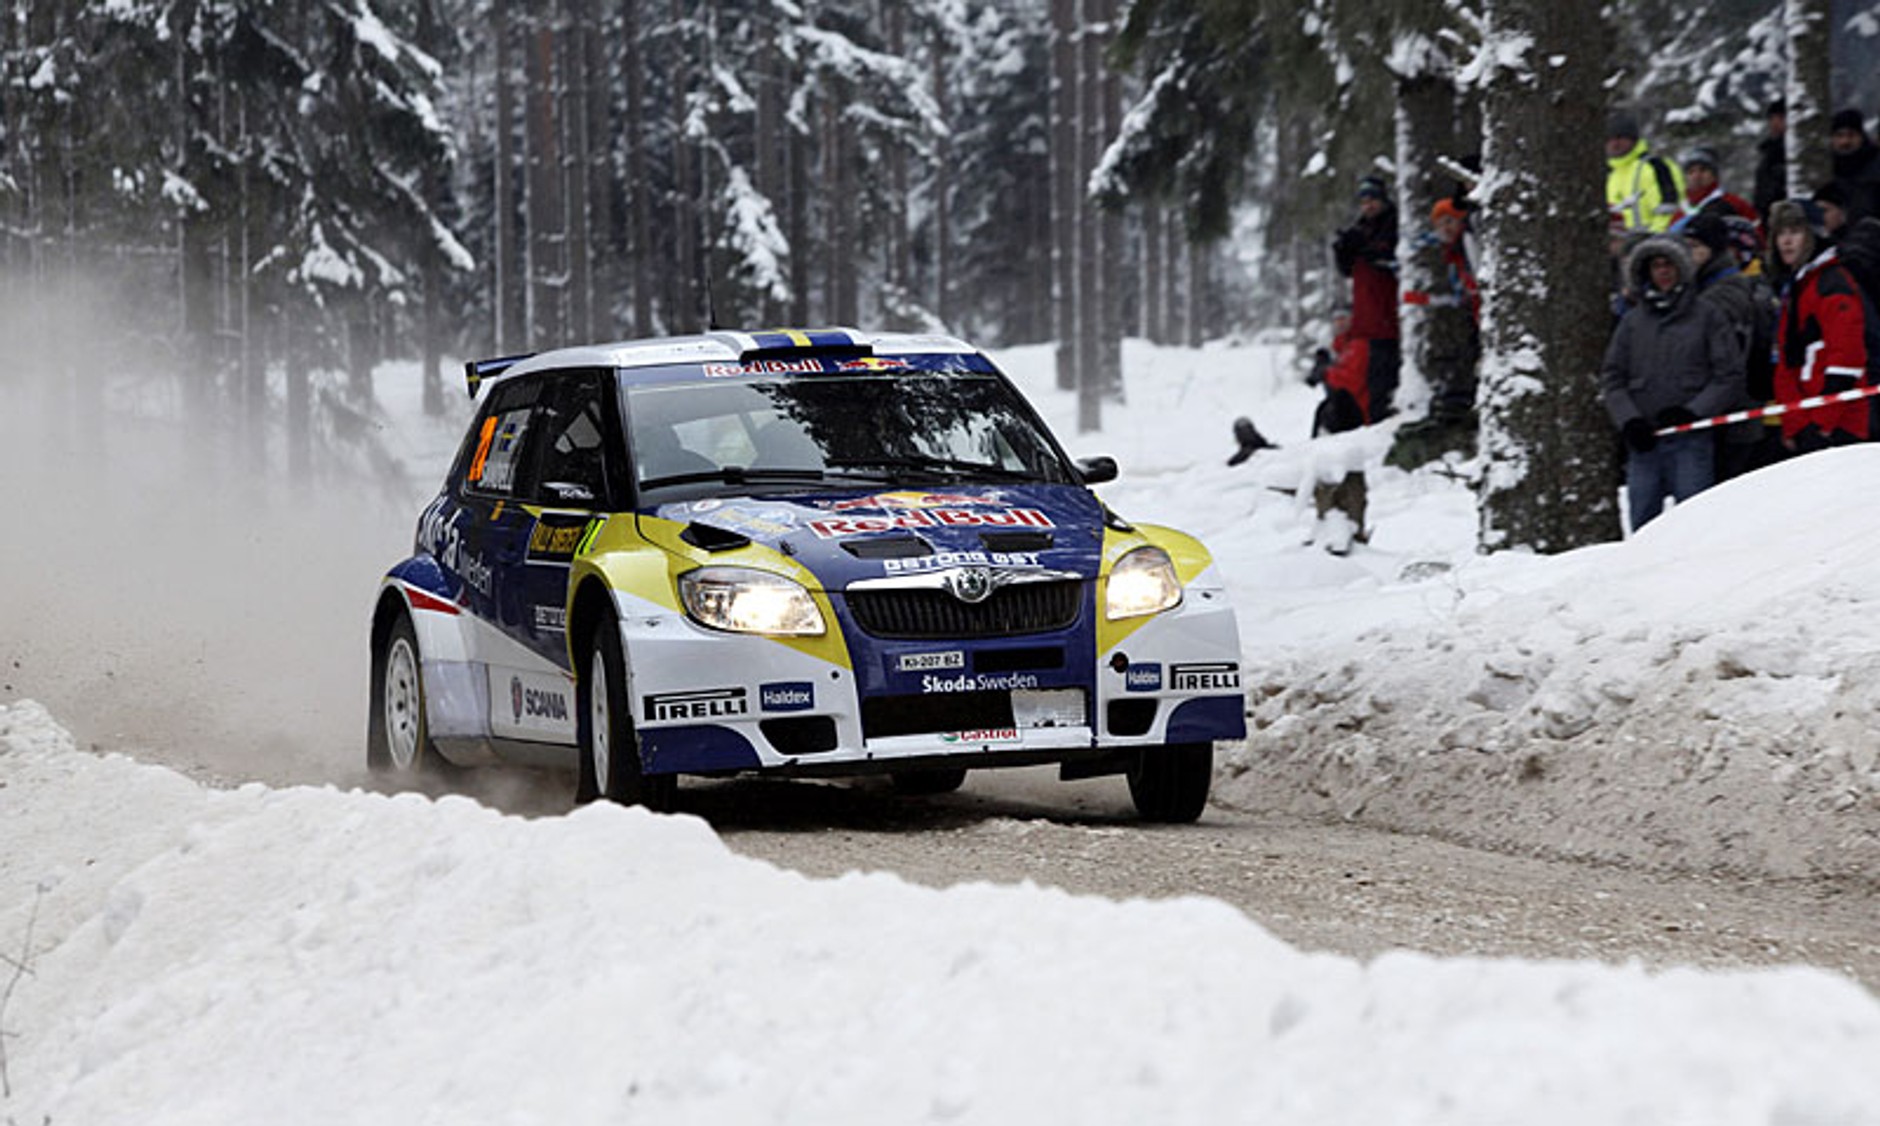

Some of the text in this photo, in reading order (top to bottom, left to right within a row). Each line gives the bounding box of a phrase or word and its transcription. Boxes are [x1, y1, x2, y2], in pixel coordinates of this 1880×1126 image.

[703, 358, 824, 378] Red Bull
[807, 508, 937, 539] Red
[931, 507, 1056, 529] Bull
[921, 671, 1038, 693] Škoda Sweden
[1169, 662, 1240, 690] PIRELLI
[525, 687, 568, 721] SCANIA
[643, 686, 748, 721] PIRELLI
[763, 689, 810, 705] Haldex
